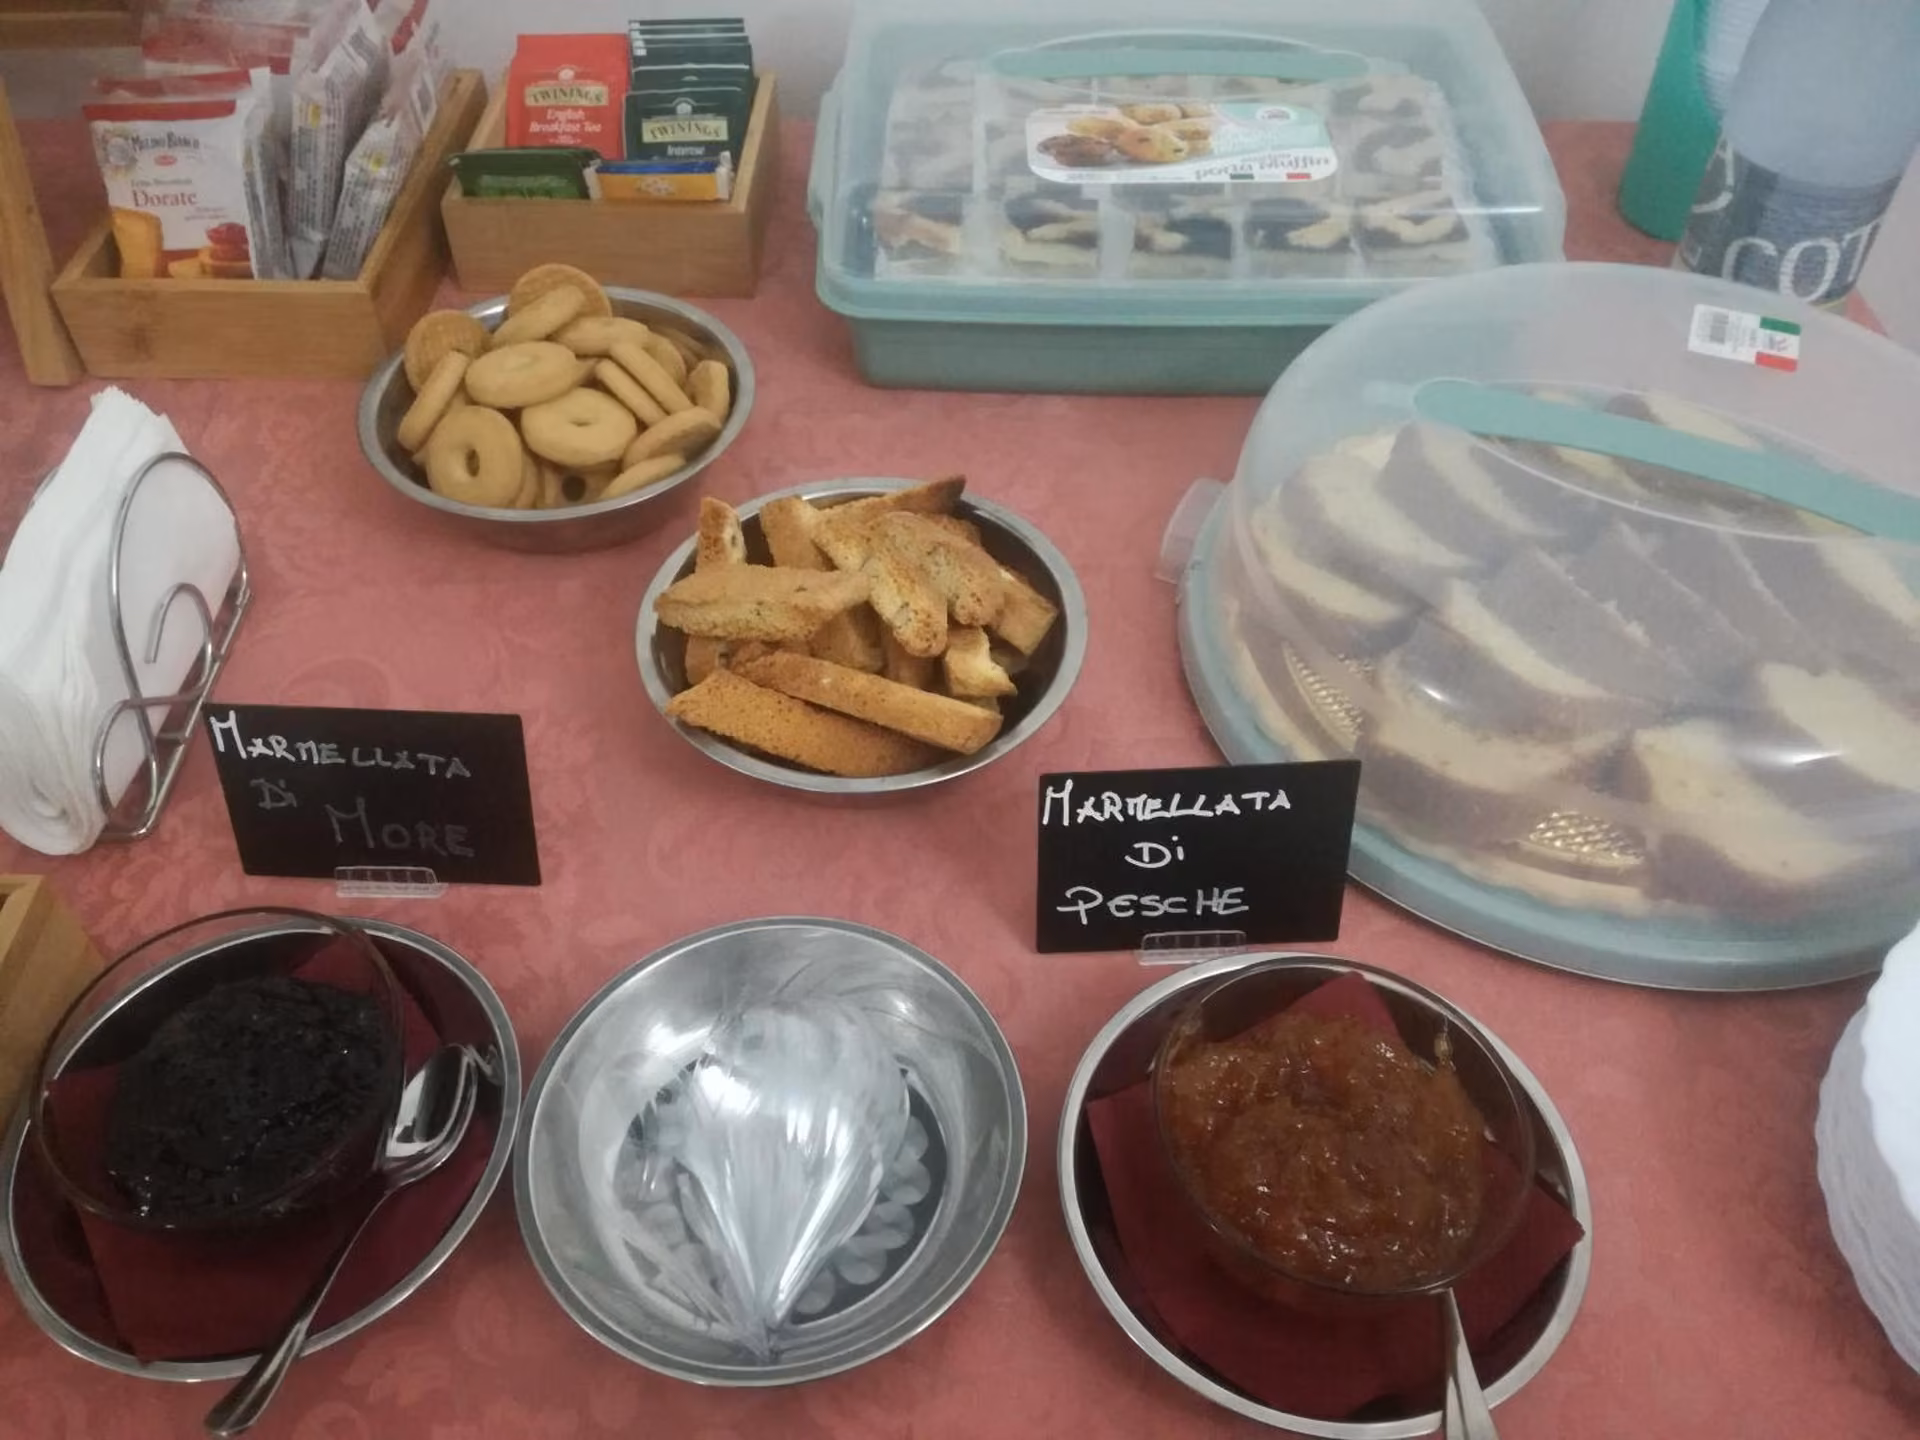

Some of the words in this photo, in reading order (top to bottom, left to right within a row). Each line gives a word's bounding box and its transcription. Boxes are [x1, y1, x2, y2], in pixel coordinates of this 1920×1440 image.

[531, 87, 603, 104] TWININGS
[649, 120, 721, 139] TWININGS
[132, 189, 198, 208] Dorate
[208, 710, 471, 779] MARMELLATA
[1042, 779, 1292, 826] MARMELLATA
[324, 796, 475, 857] MORE
[1056, 886, 1250, 925] PESCHE
